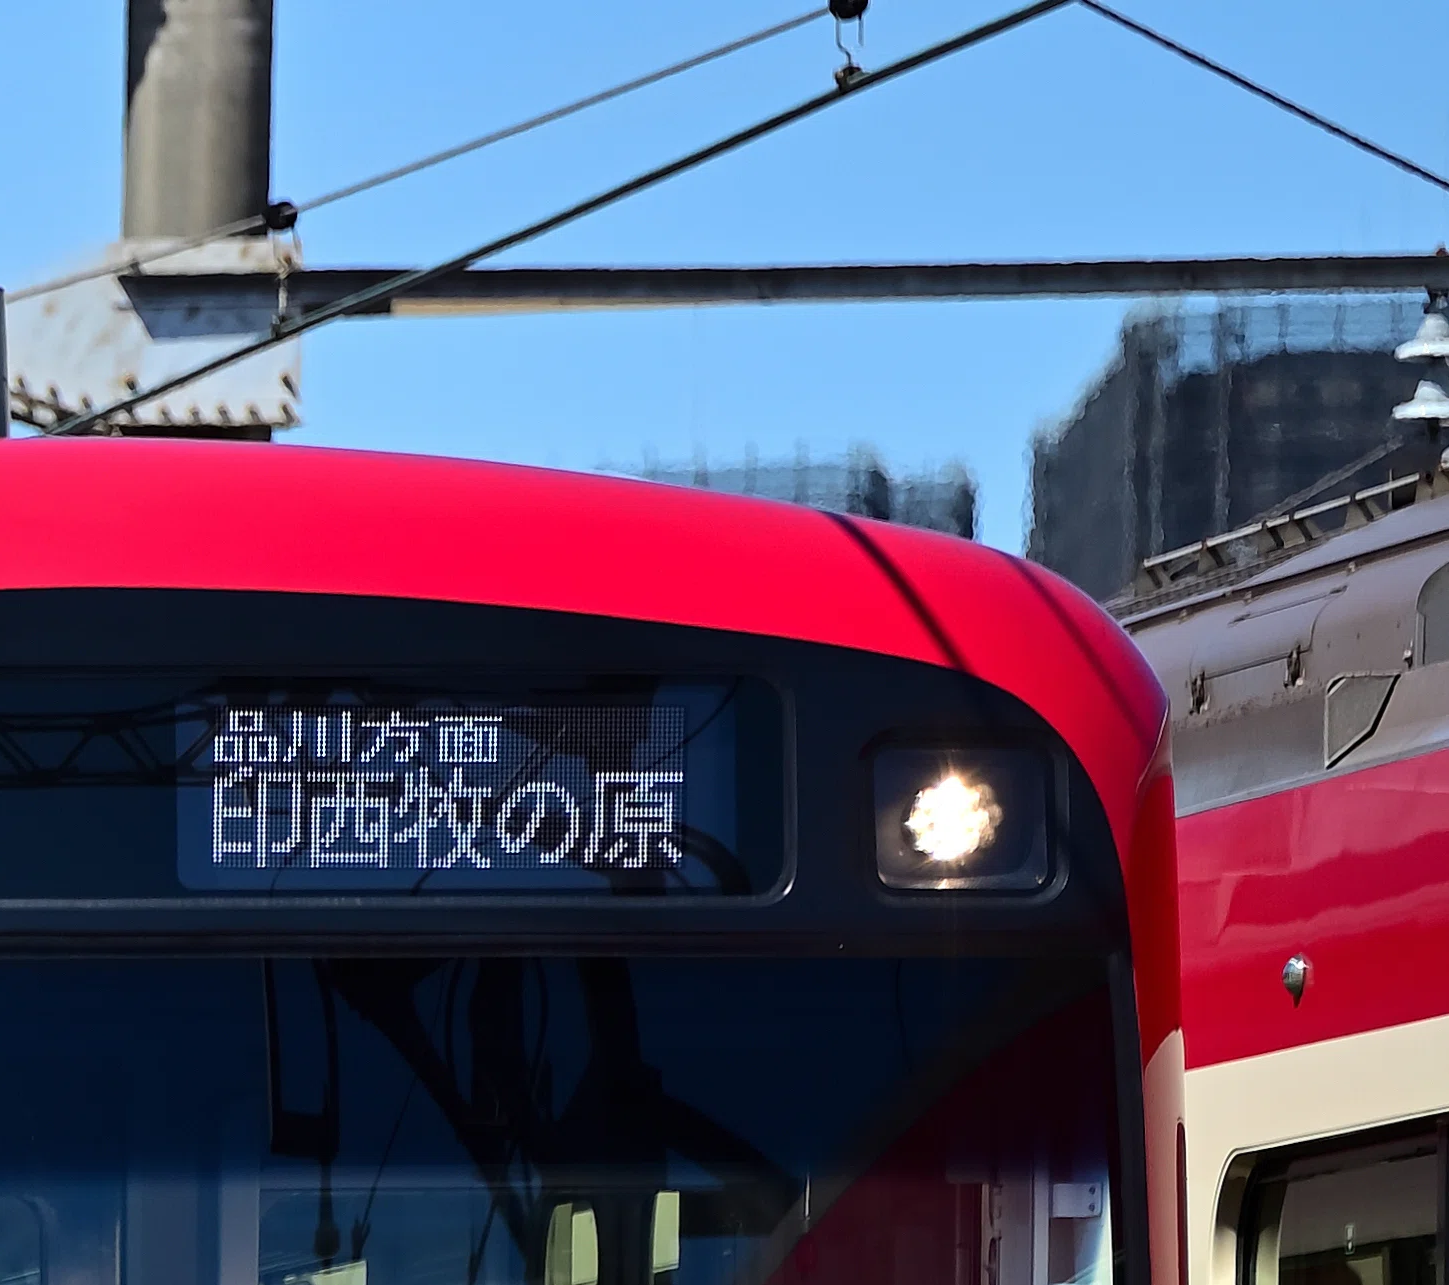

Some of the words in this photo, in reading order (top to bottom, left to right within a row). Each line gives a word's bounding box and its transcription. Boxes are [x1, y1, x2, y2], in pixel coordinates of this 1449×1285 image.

[212, 709, 505, 764] 品川方面
[211, 765, 685, 869] 印西牧の原
